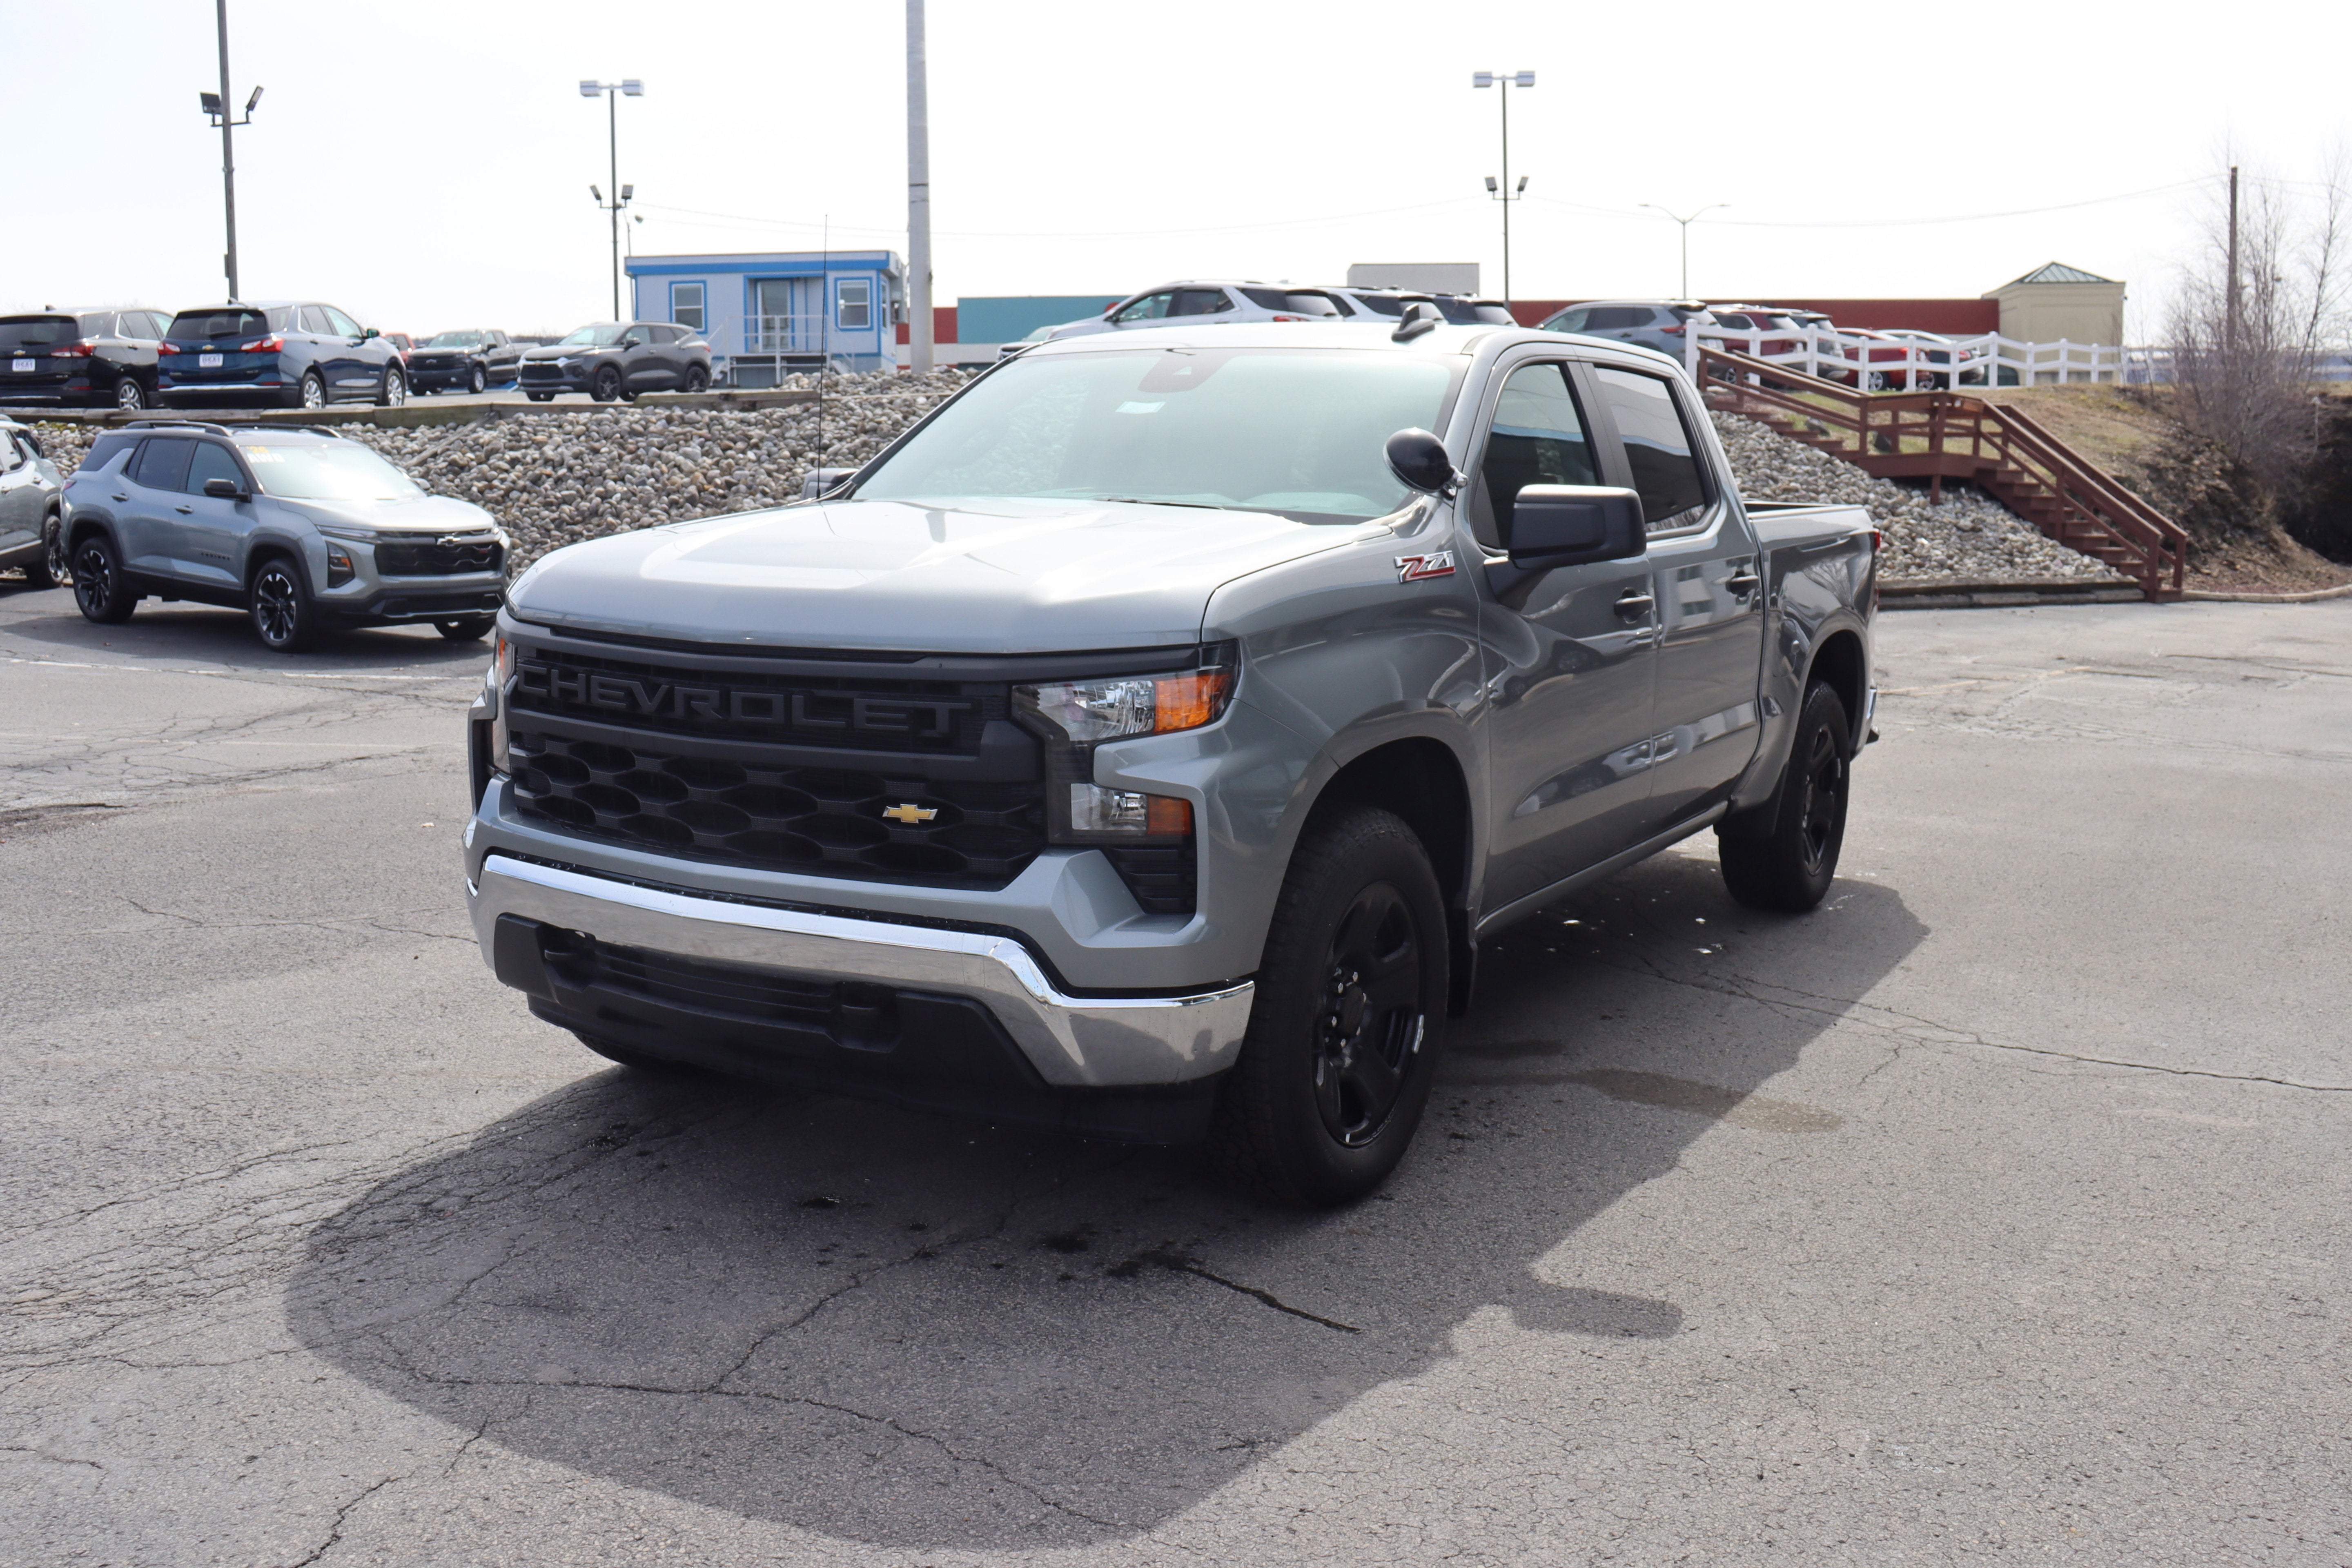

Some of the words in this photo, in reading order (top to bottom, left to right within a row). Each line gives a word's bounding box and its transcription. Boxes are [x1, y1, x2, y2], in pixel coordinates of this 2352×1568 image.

[247, 453, 285, 463] AWD
[1394, 550, 1456, 583] Z71
[517, 663, 971, 734] CHEVROLET
